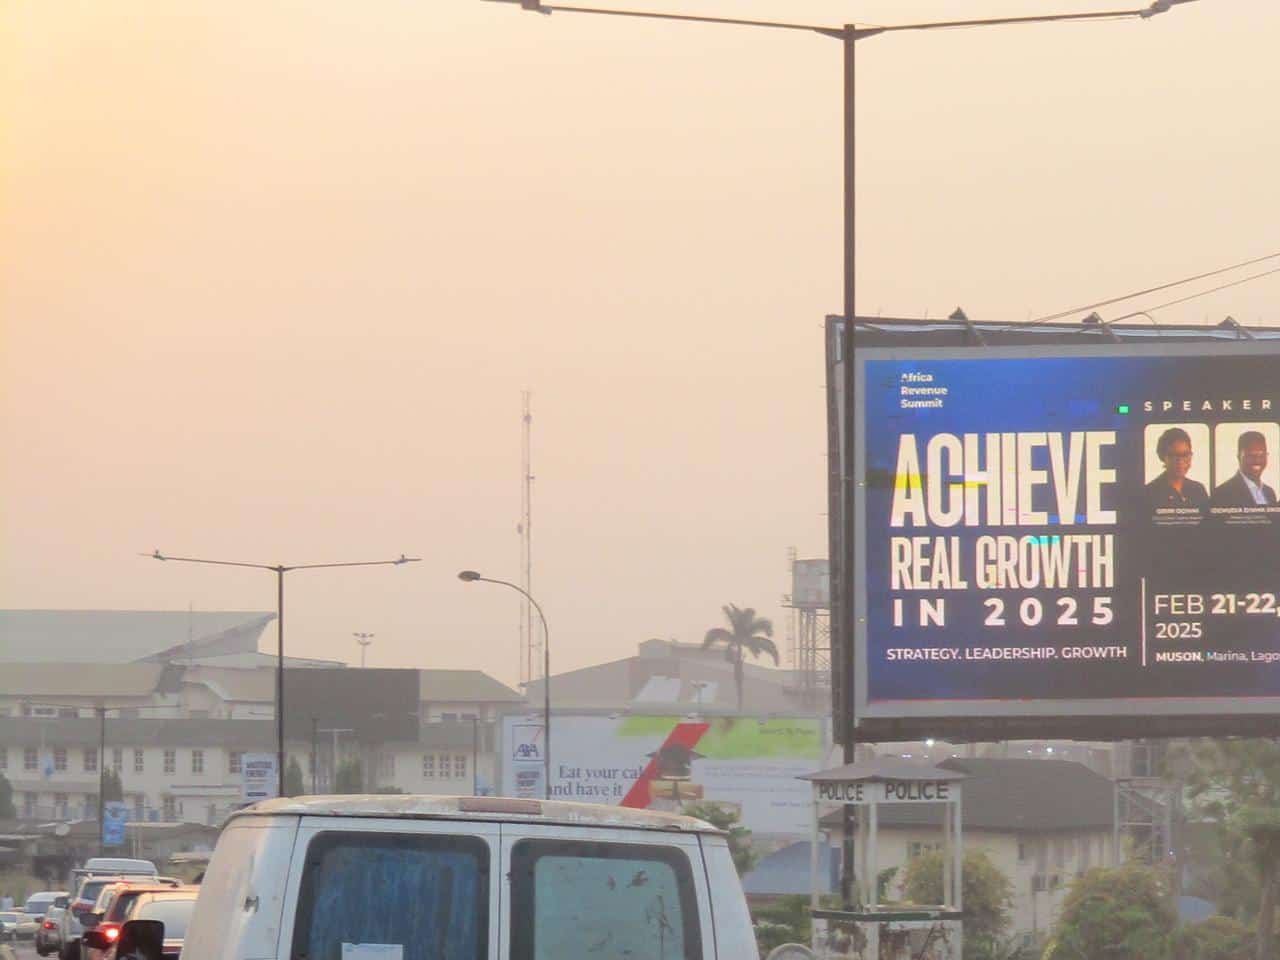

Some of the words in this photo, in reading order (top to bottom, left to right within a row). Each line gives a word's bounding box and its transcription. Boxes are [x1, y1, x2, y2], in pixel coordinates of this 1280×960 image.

[900, 372, 933, 383] Africa
[900, 386, 948, 396] Revenue
[900, 398, 943, 409] Summit
[890, 431, 1116, 528] ACHIEVE
[890, 536, 968, 590] REAL
[975, 534, 1115, 589] GROWTH
[893, 598, 946, 627] IN
[983, 596, 1114, 626] 2025
[1155, 594, 1204, 615] FEB
[1155, 622, 1202, 639] 2025
[886, 647, 962, 661] STRATEGY.
[965, 646, 1058, 660] LEADERSHIP.
[1061, 645, 1128, 659] GROWTH
[1206, 651, 1248, 661] Marina,
[559, 765, 581, 779] Eat
[584, 767, 619, 782] your
[576, 782, 609, 796] have
[613, 782, 624, 796] it
[819, 783, 864, 801] POLICE
[885, 783, 949, 800] POLICE
